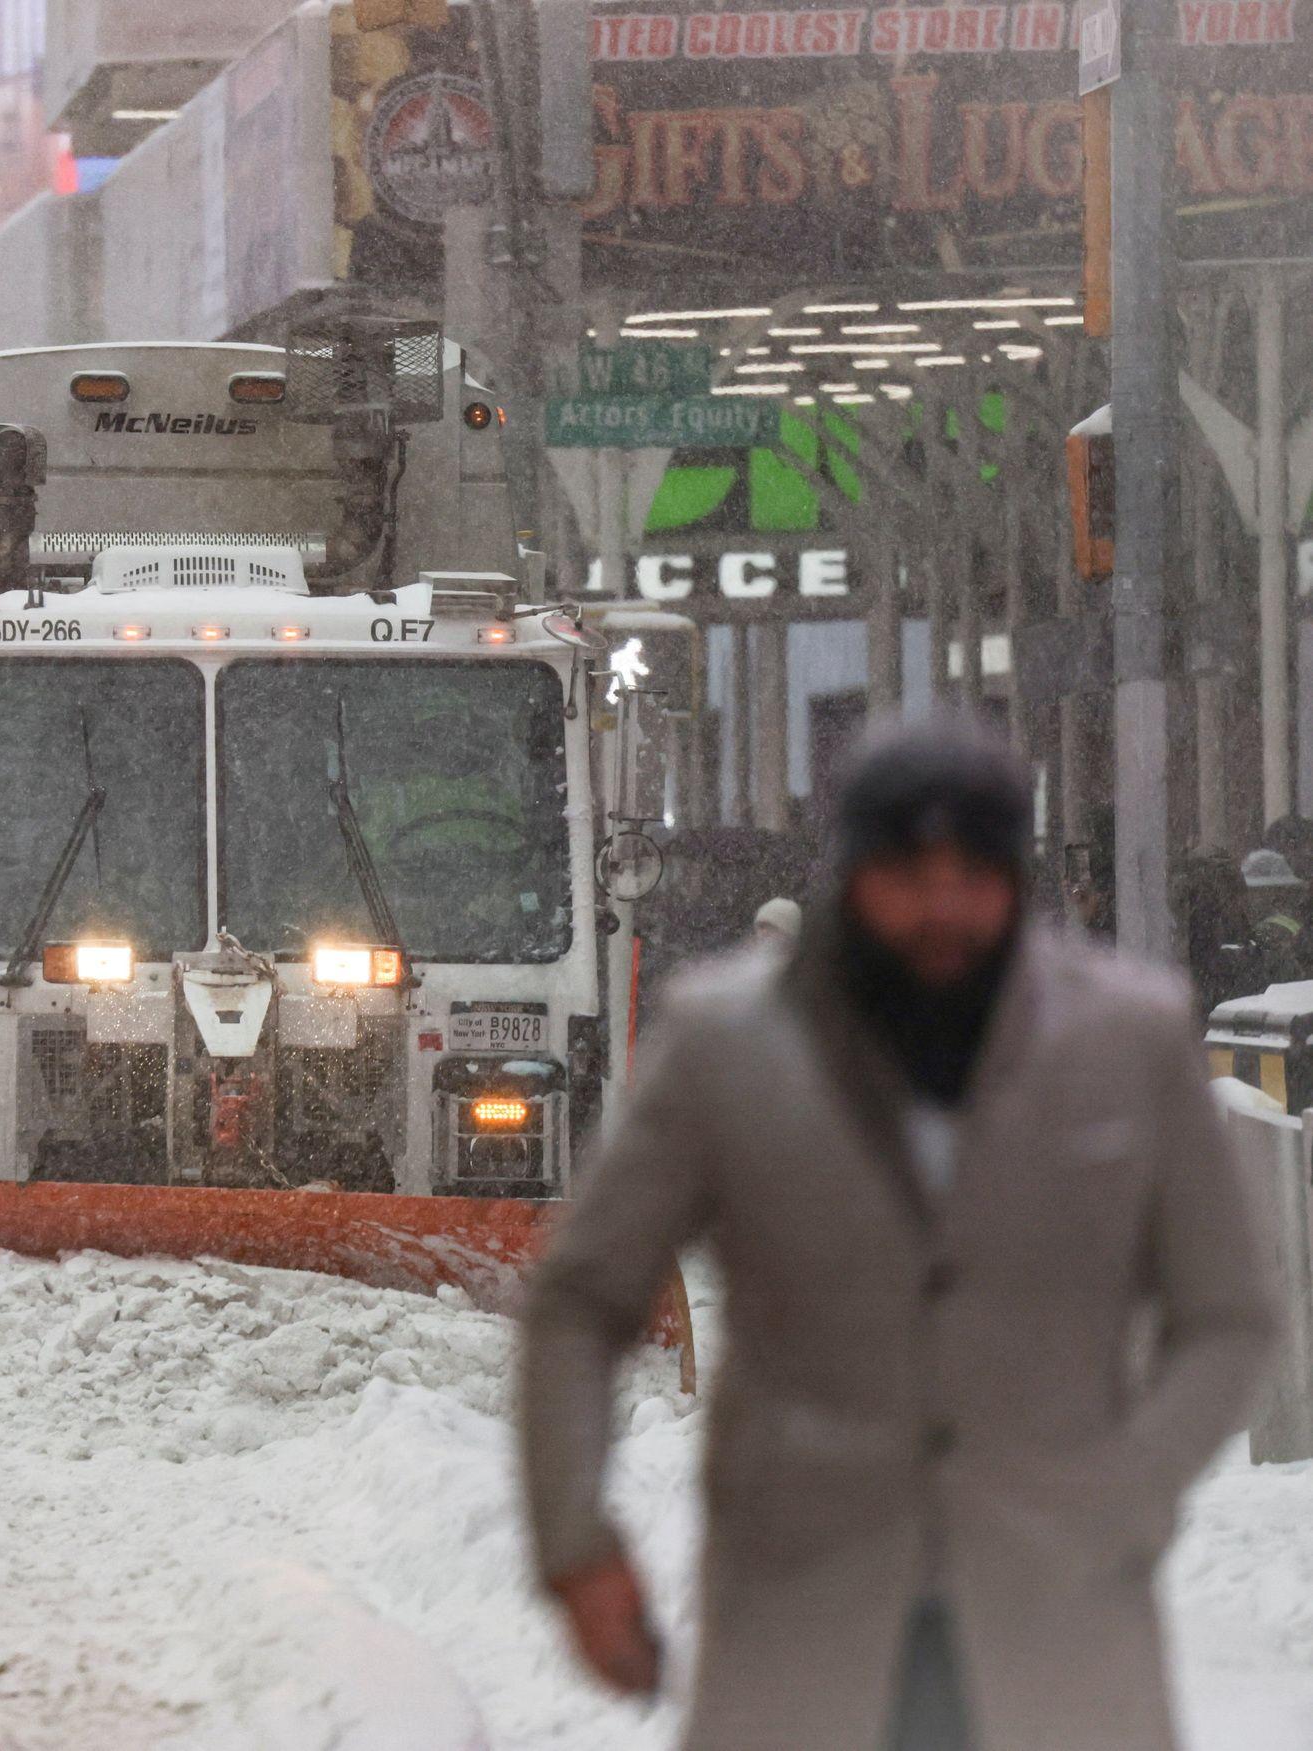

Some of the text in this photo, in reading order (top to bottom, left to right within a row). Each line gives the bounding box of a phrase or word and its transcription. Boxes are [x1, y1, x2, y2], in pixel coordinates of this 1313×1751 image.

[685, 11, 863, 58] COOLEST
[871, 6, 1007, 54] STORE
[1012, 3, 1065, 52] IN
[841, 144, 876, 186] &
[890, 70, 1313, 212] LUGAGE
[94, 412, 259, 435] McNeilus
